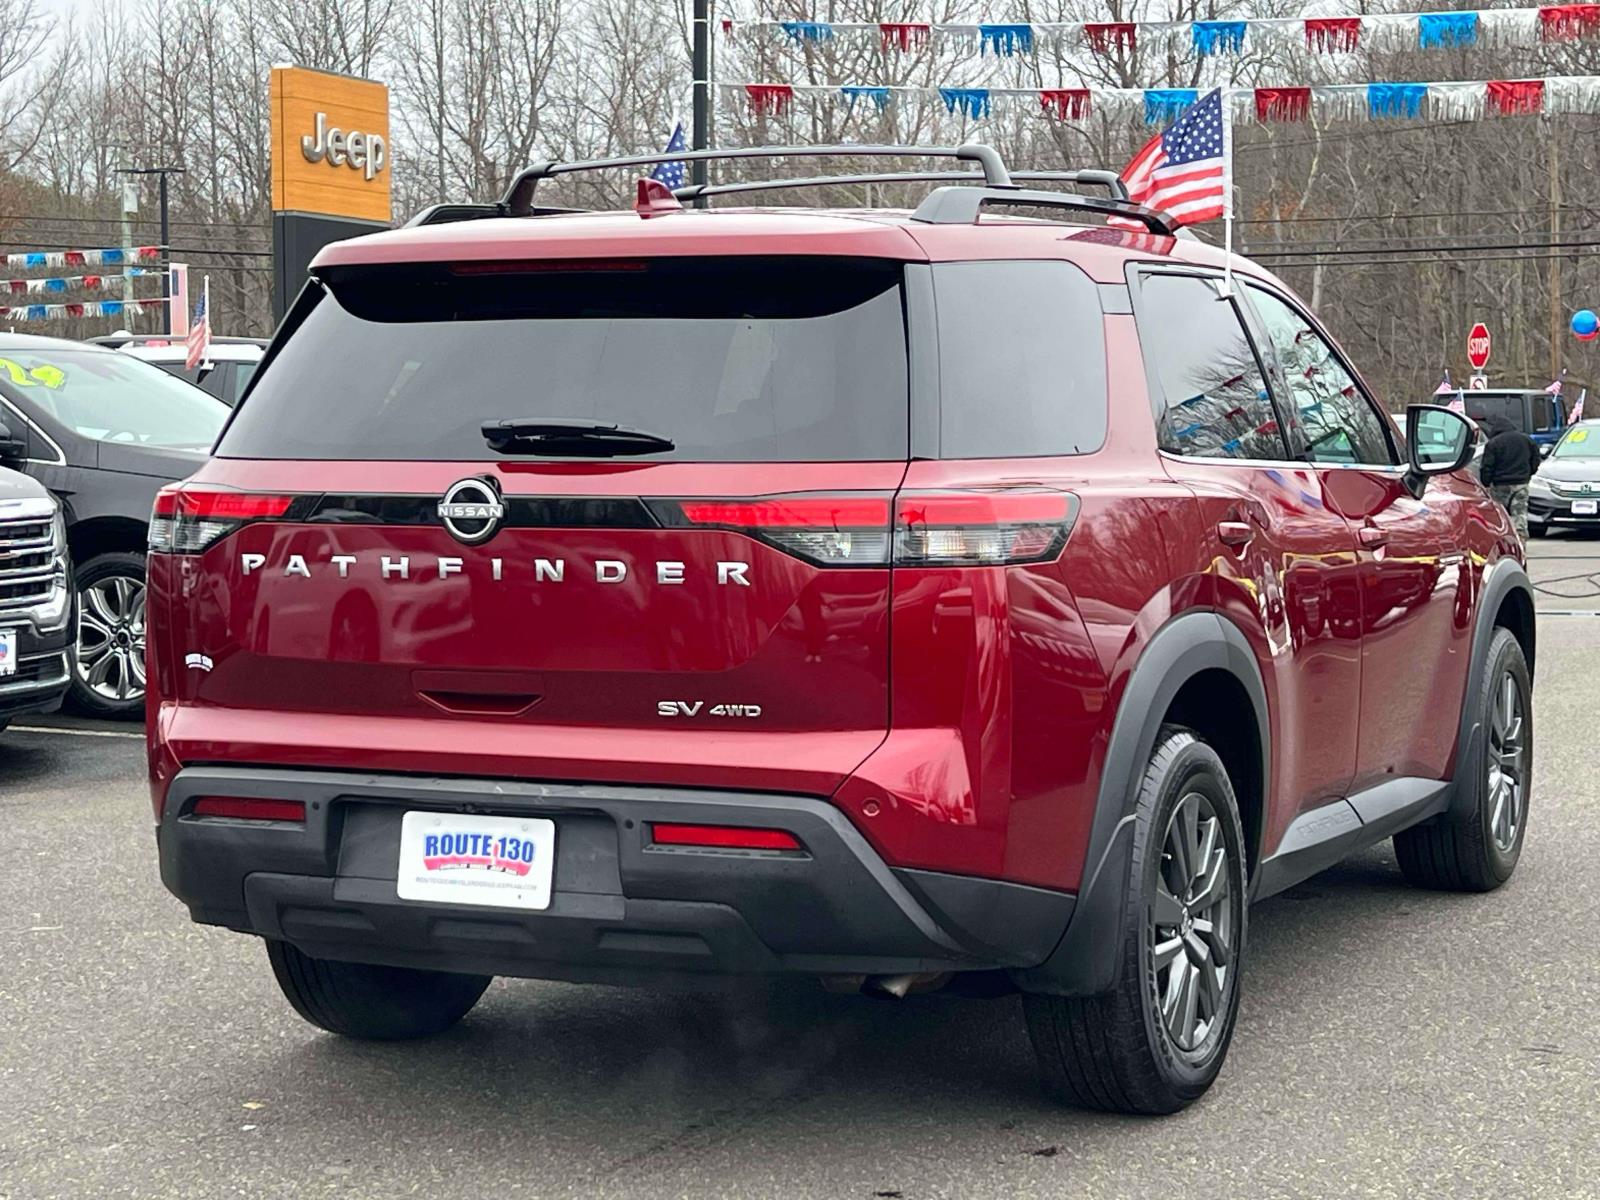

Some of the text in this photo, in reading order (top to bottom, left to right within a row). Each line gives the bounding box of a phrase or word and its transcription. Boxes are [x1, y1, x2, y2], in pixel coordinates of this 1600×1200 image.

[301, 112, 385, 181] Jeep
[1470, 337, 1488, 355] STOP
[438, 506, 502, 518] NISSAN
[241, 553, 751, 587] PATHFINDER
[657, 700, 761, 717] SV 4WD
[425, 834, 534, 863] ROUTE 130
